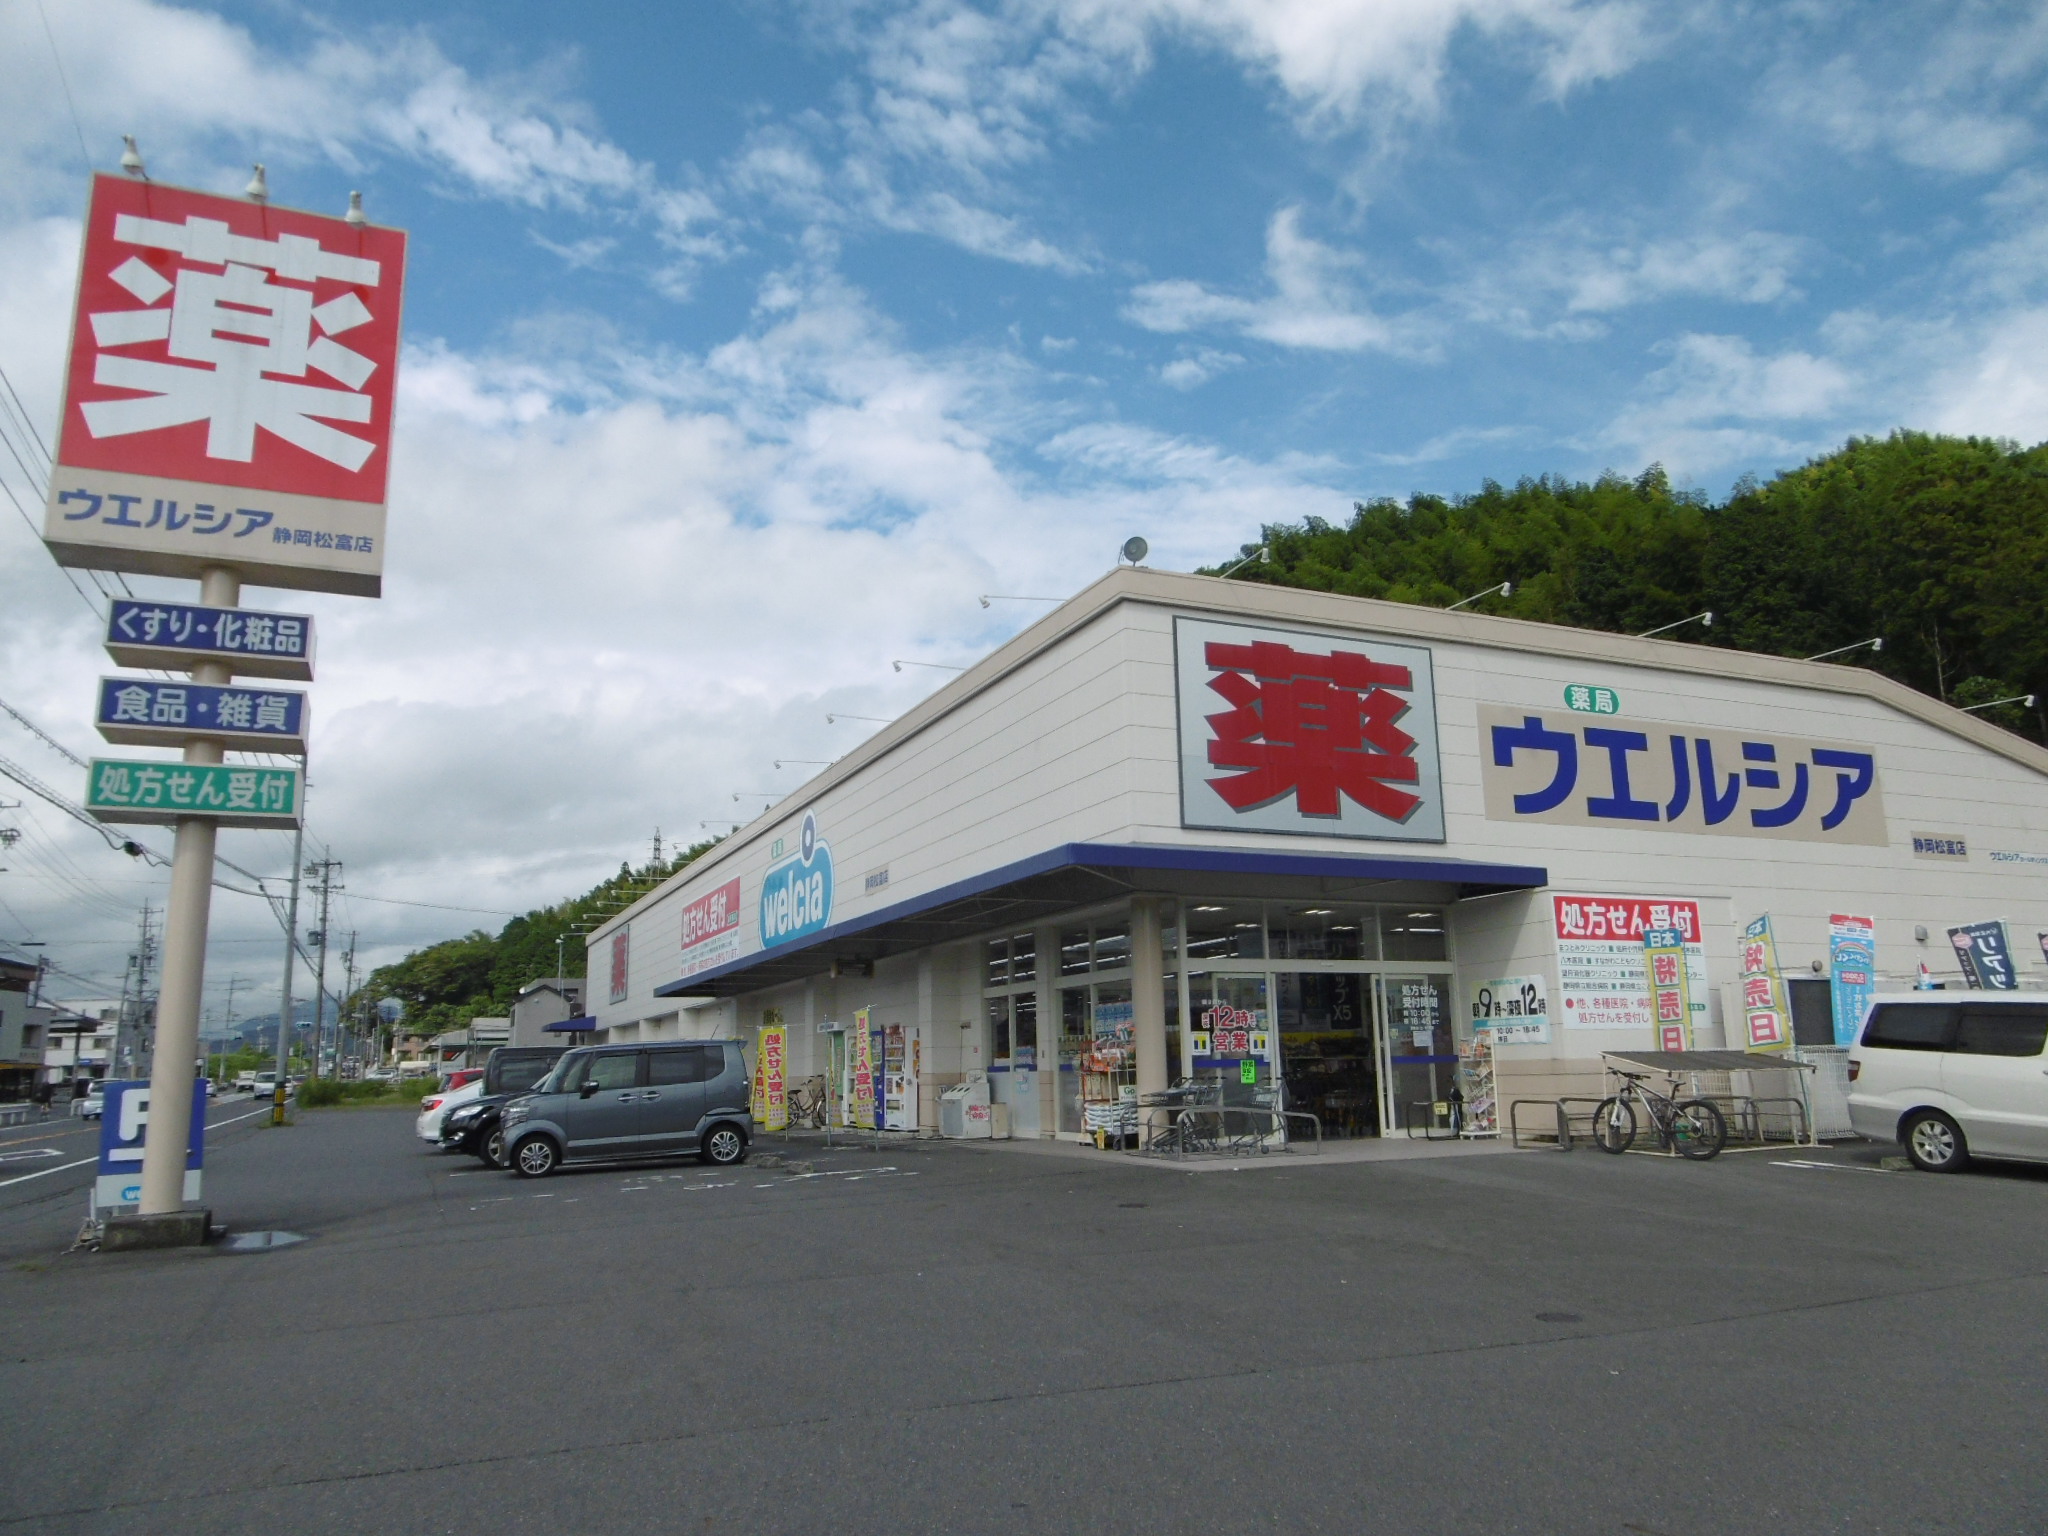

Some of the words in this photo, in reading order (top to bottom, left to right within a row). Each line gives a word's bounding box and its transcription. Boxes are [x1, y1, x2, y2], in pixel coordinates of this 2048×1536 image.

[79, 212, 381, 473] 薬
[58, 488, 274, 538] ウエルシア
[272, 526, 374, 554] 静岡松富店
[117, 607, 302, 653] くすり・化粧品
[112, 685, 290, 731] 食品・雑貨
[1570, 686, 1615, 714] 薬局
[1204, 640, 1422, 822] 薬
[97, 765, 289, 810] 処方せん受付
[1492, 716, 1874, 831] ウエルシア
[682, 890, 727, 945] 処方せん受付
[763, 869, 823, 939] welcia
[1560, 901, 1693, 938] 処方せん受付
